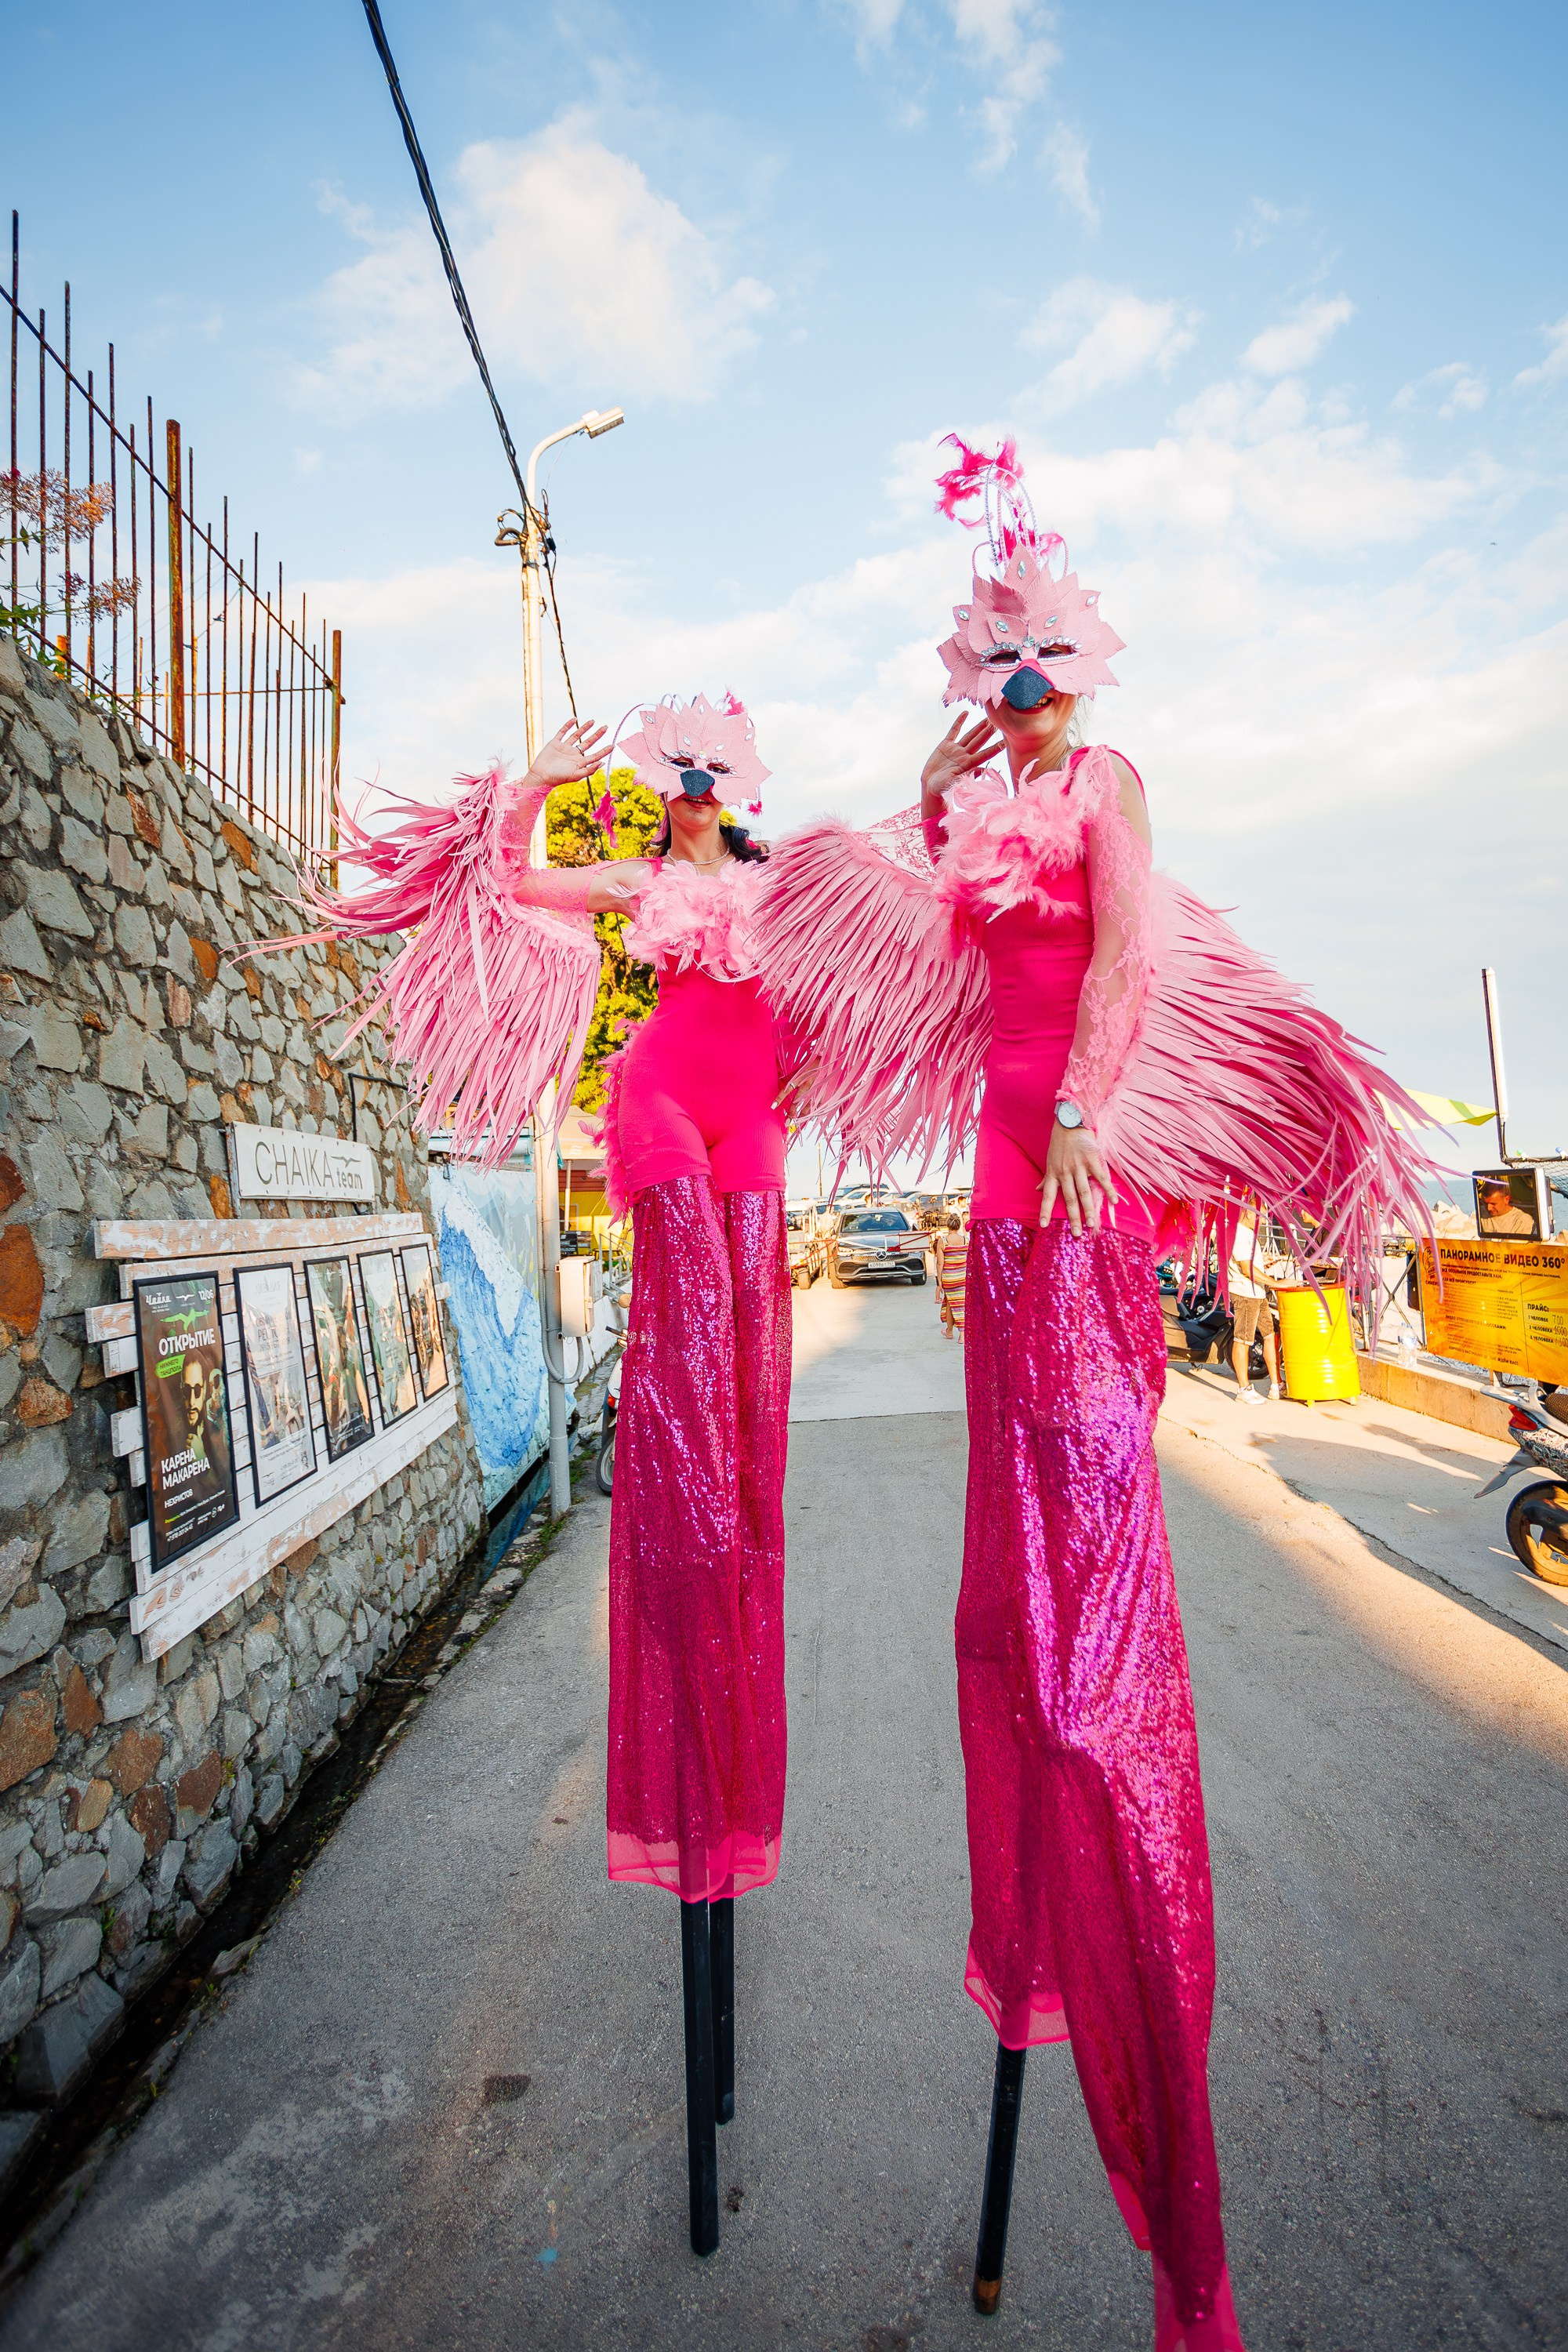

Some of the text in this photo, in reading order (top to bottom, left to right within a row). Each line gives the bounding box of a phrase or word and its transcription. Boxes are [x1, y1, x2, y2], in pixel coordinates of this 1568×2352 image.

[255, 1141, 363, 1190] CHAIKA team
[1440, 1248, 1566, 1269] ПАНОРАМНОЕ ВИДЕО 360°
[198, 1288, 214, 1301] 12/06
[1527, 1303, 1549, 1312] ПРАЙС:
[158, 1327, 216, 1356] ОТКРЫТИЕ
[161, 1447, 197, 1474] КАРЕНА
[162, 1457, 210, 1490] МАКАРЕНА
